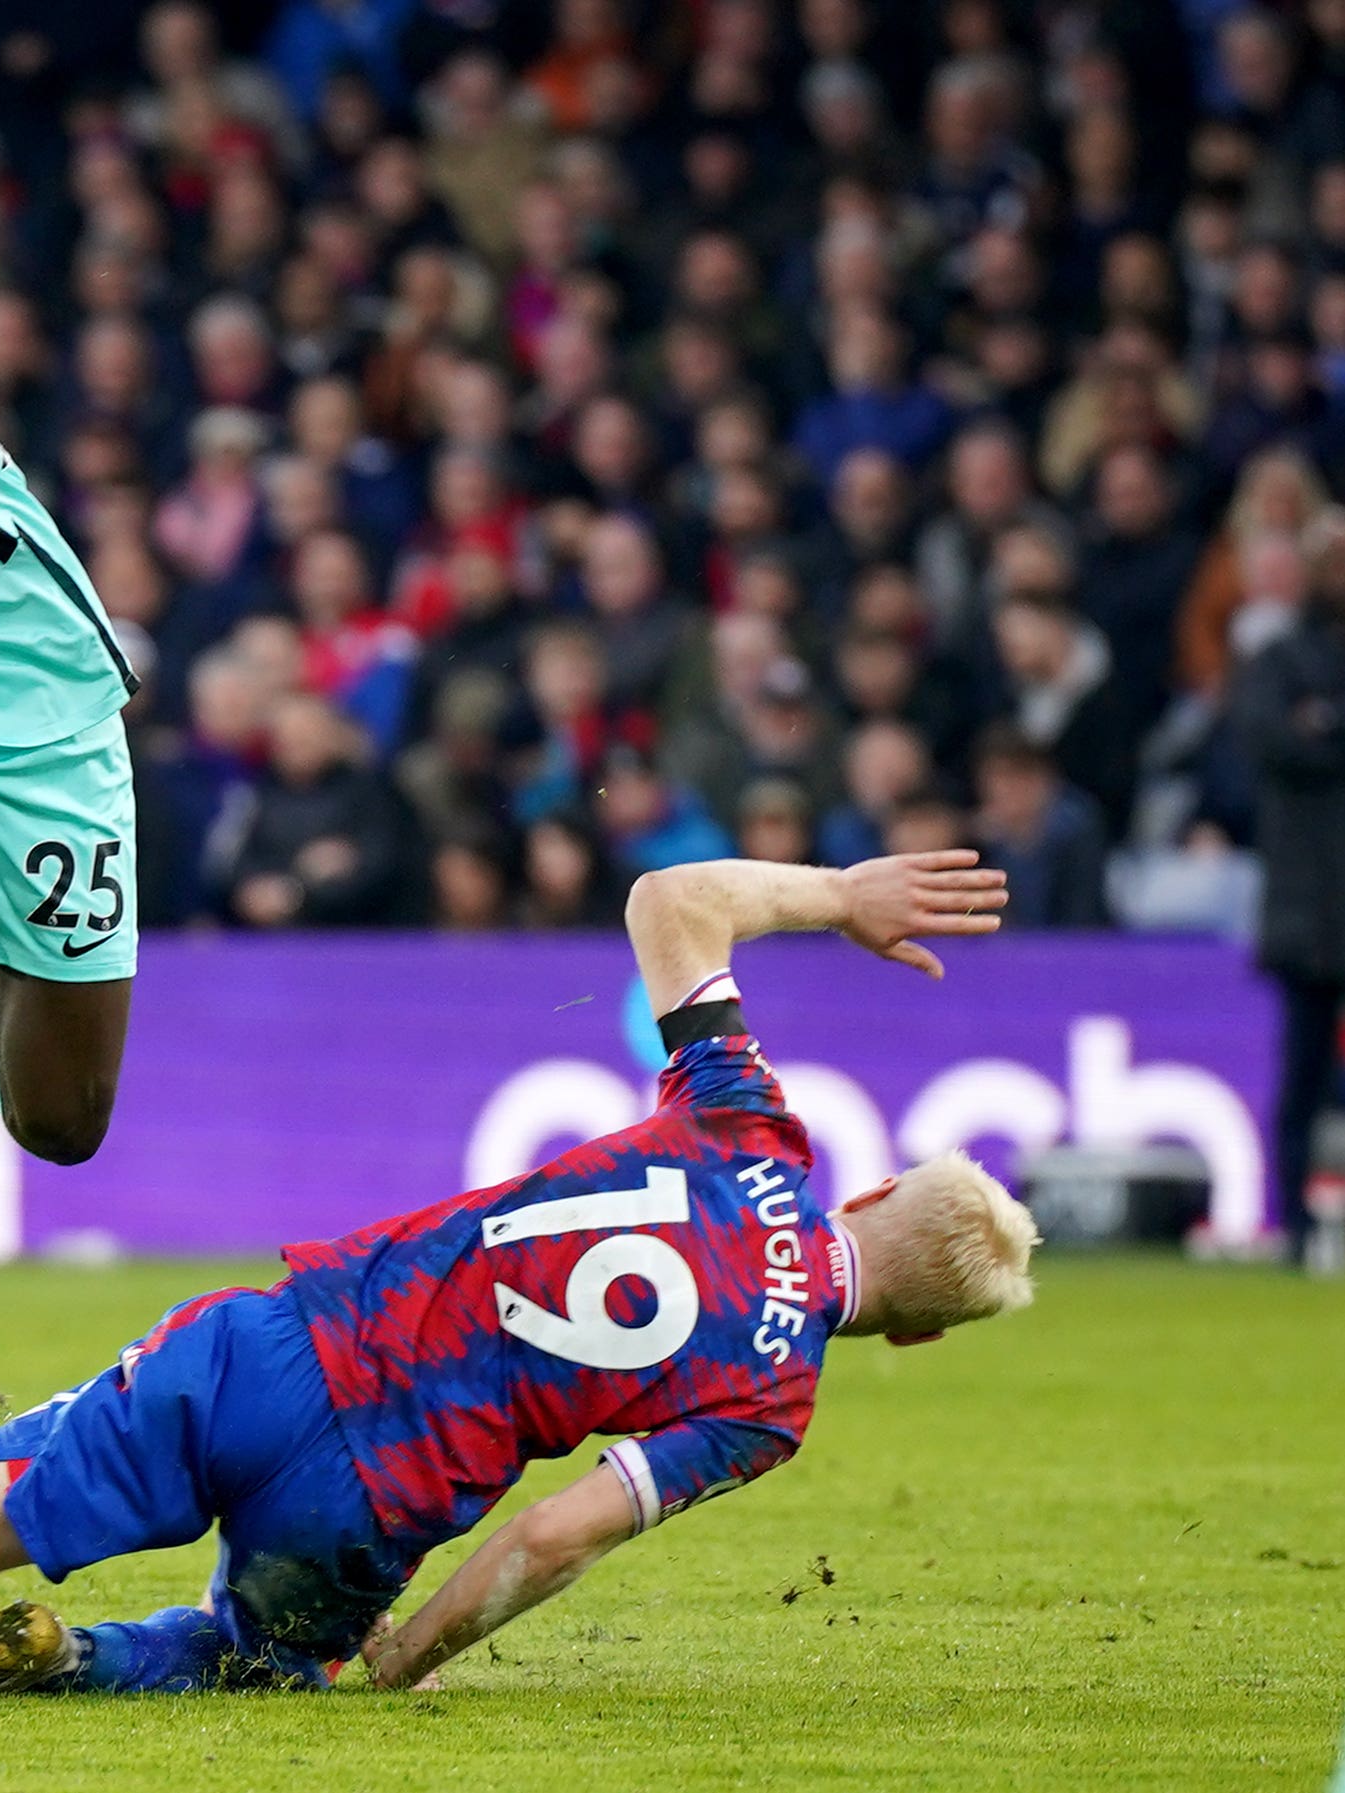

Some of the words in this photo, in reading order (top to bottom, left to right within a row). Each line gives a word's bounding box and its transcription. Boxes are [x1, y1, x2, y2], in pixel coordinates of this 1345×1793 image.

[25, 840, 125, 933] 25
[482, 1165, 700, 1370] 19
[736, 1157, 811, 1366] HUGHES
